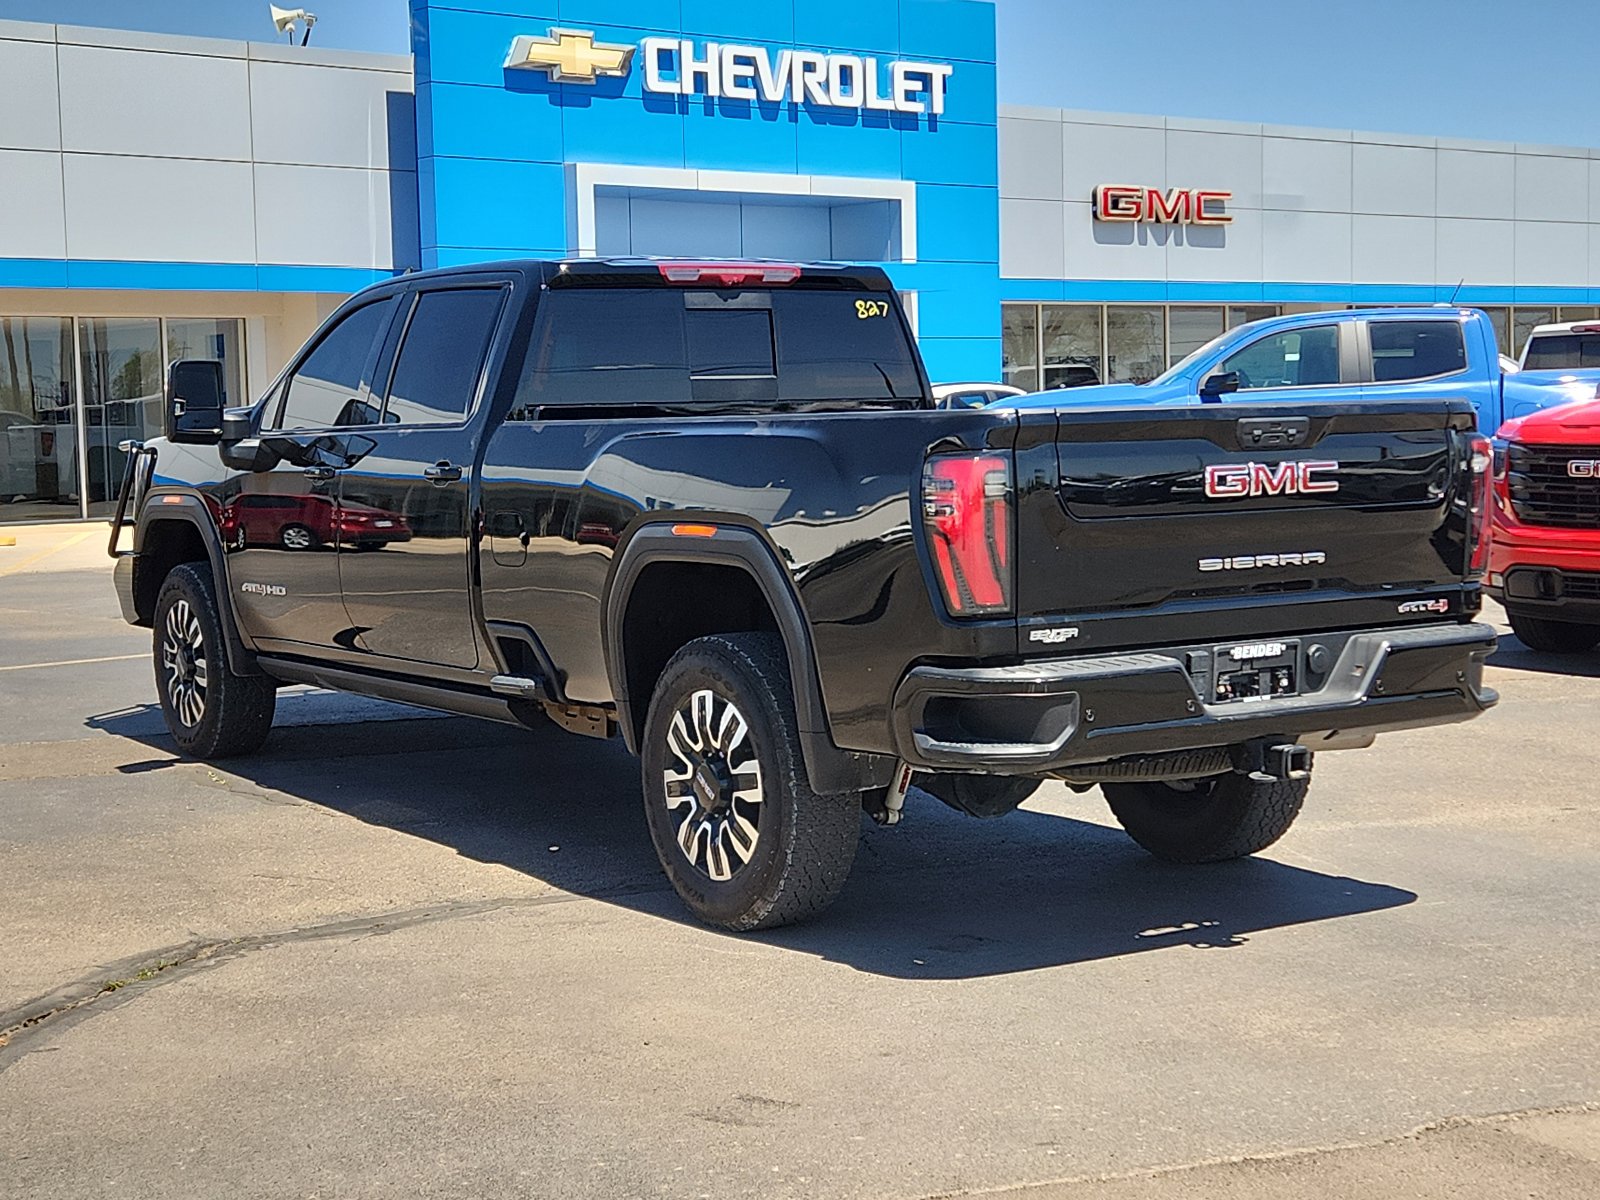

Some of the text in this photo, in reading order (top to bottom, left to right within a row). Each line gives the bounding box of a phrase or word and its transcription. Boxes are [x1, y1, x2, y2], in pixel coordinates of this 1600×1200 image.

[643, 37, 953, 115] CHEVROLET
[1092, 184, 1234, 225] GMC
[855, 299, 889, 319] 827
[1204, 461, 1340, 498] GMC
[1198, 551, 1326, 572] SIERRA
[1231, 643, 1284, 660] BENDER
